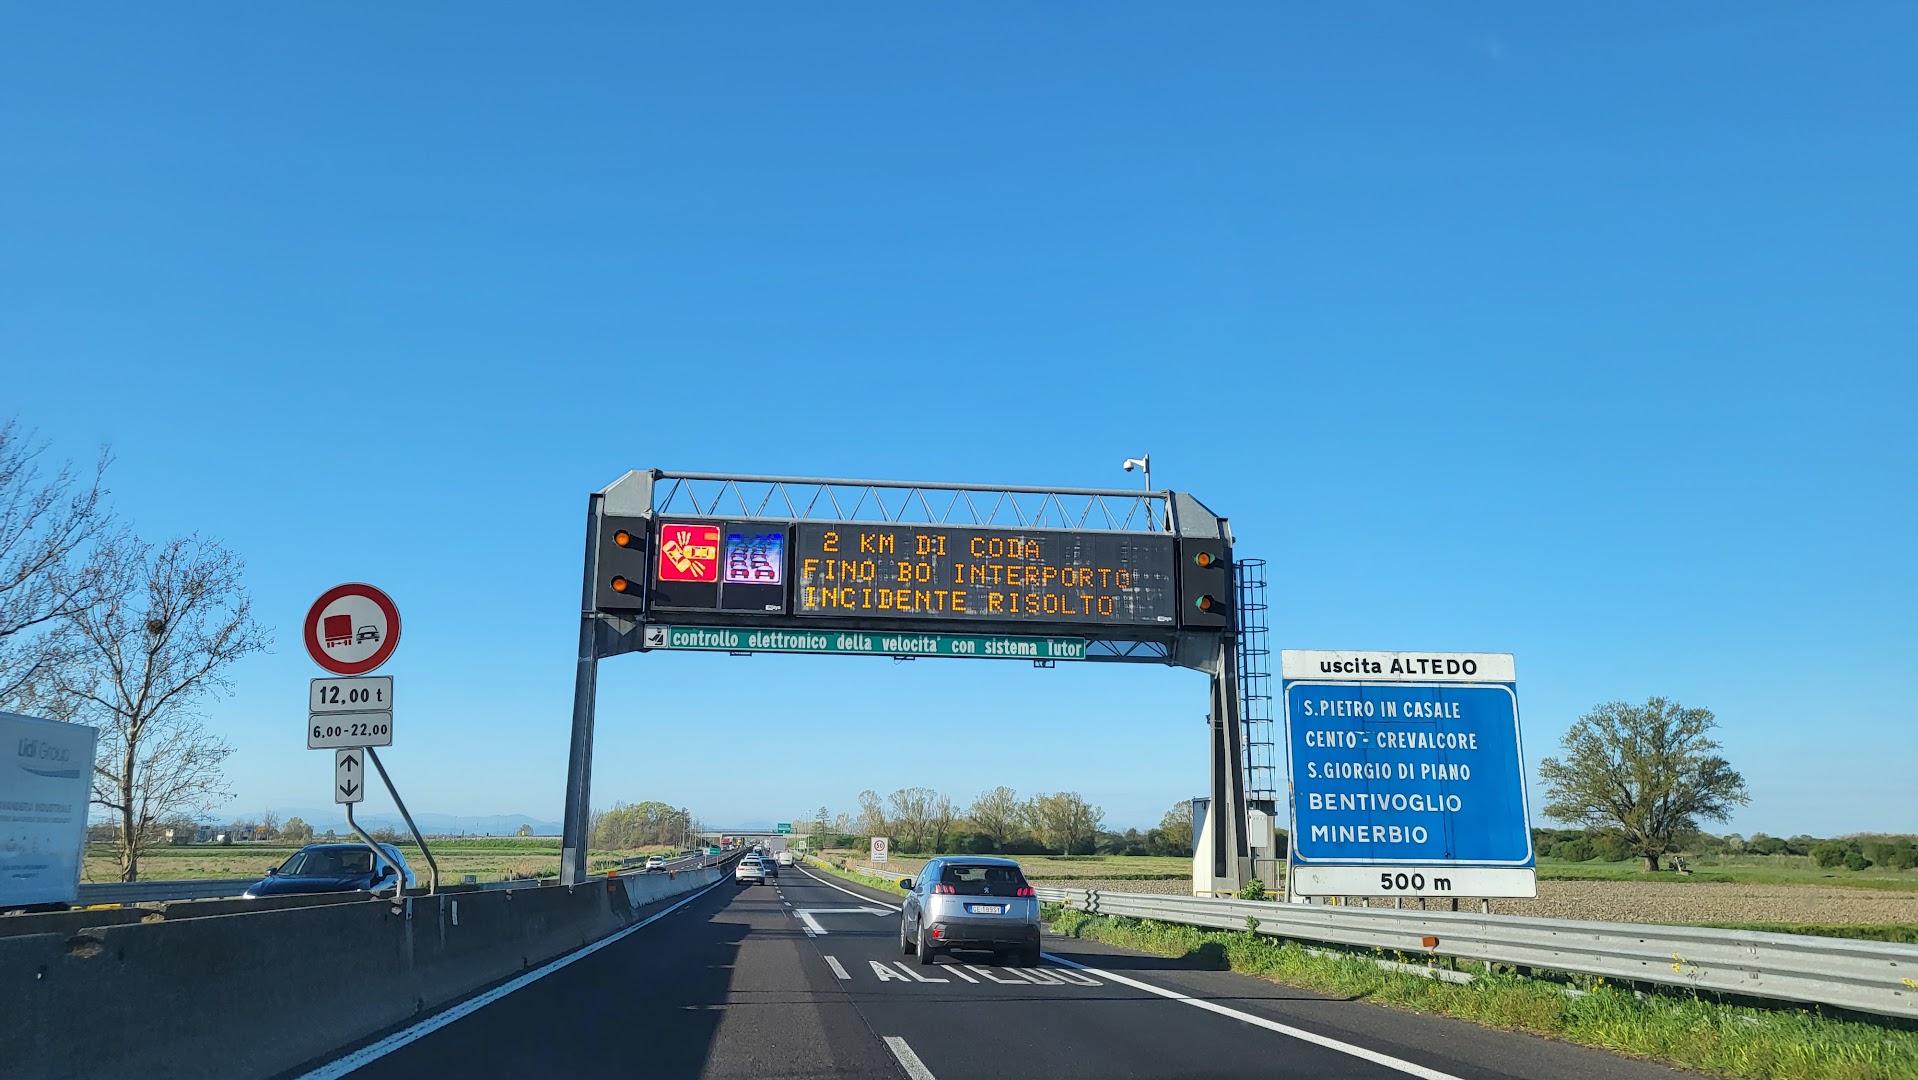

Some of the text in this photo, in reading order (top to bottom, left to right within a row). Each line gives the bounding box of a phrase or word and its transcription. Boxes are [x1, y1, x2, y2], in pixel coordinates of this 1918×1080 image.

[823, 531, 1040, 559] 2 KM DI CODA
[803, 558, 1130, 588] FINO BO INTERPORTO
[805, 586, 1113, 616] INCIDENTE RISOLTO
[672, 629, 739, 647] controllo
[748, 630, 827, 649] elettronico
[836, 633, 872, 650] della
[951, 639, 975, 654] con
[985, 638, 1037, 656] sistema
[1047, 639, 1082, 657] Tutor
[1320, 658, 1478, 676] uscita ALTEDO
[320, 686, 383, 705] 12,00 t
[1303, 699, 1461, 719] S.PIETRO IN CASALE
[1305, 730, 1357, 749] CENTO
[1376, 731, 1478, 750] CREVALCORE
[17, 737, 71, 765] Lidi Group
[1307, 761, 1471, 781] S.GIORGIO DI PIANO
[1309, 792, 1462, 813] BENTIVOGLIO
[1311, 825, 1428, 844] MINERBIO
[1380, 873, 1452, 891] 500 m
